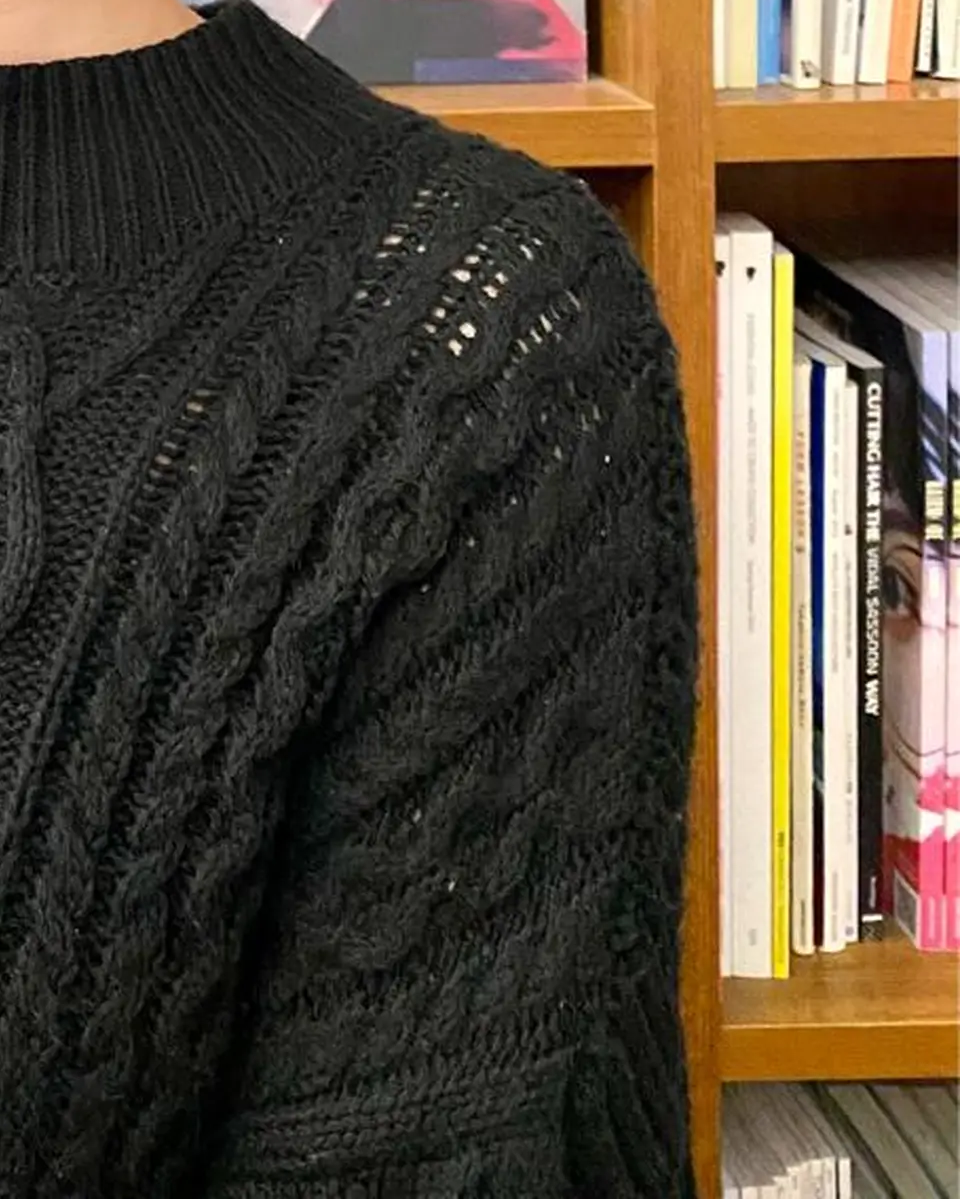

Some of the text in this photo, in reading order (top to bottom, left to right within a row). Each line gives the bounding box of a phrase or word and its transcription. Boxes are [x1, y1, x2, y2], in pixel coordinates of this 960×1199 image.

[864, 381, 883, 717] CUTTING HAIR THE VIDAL SASSOON WAY
